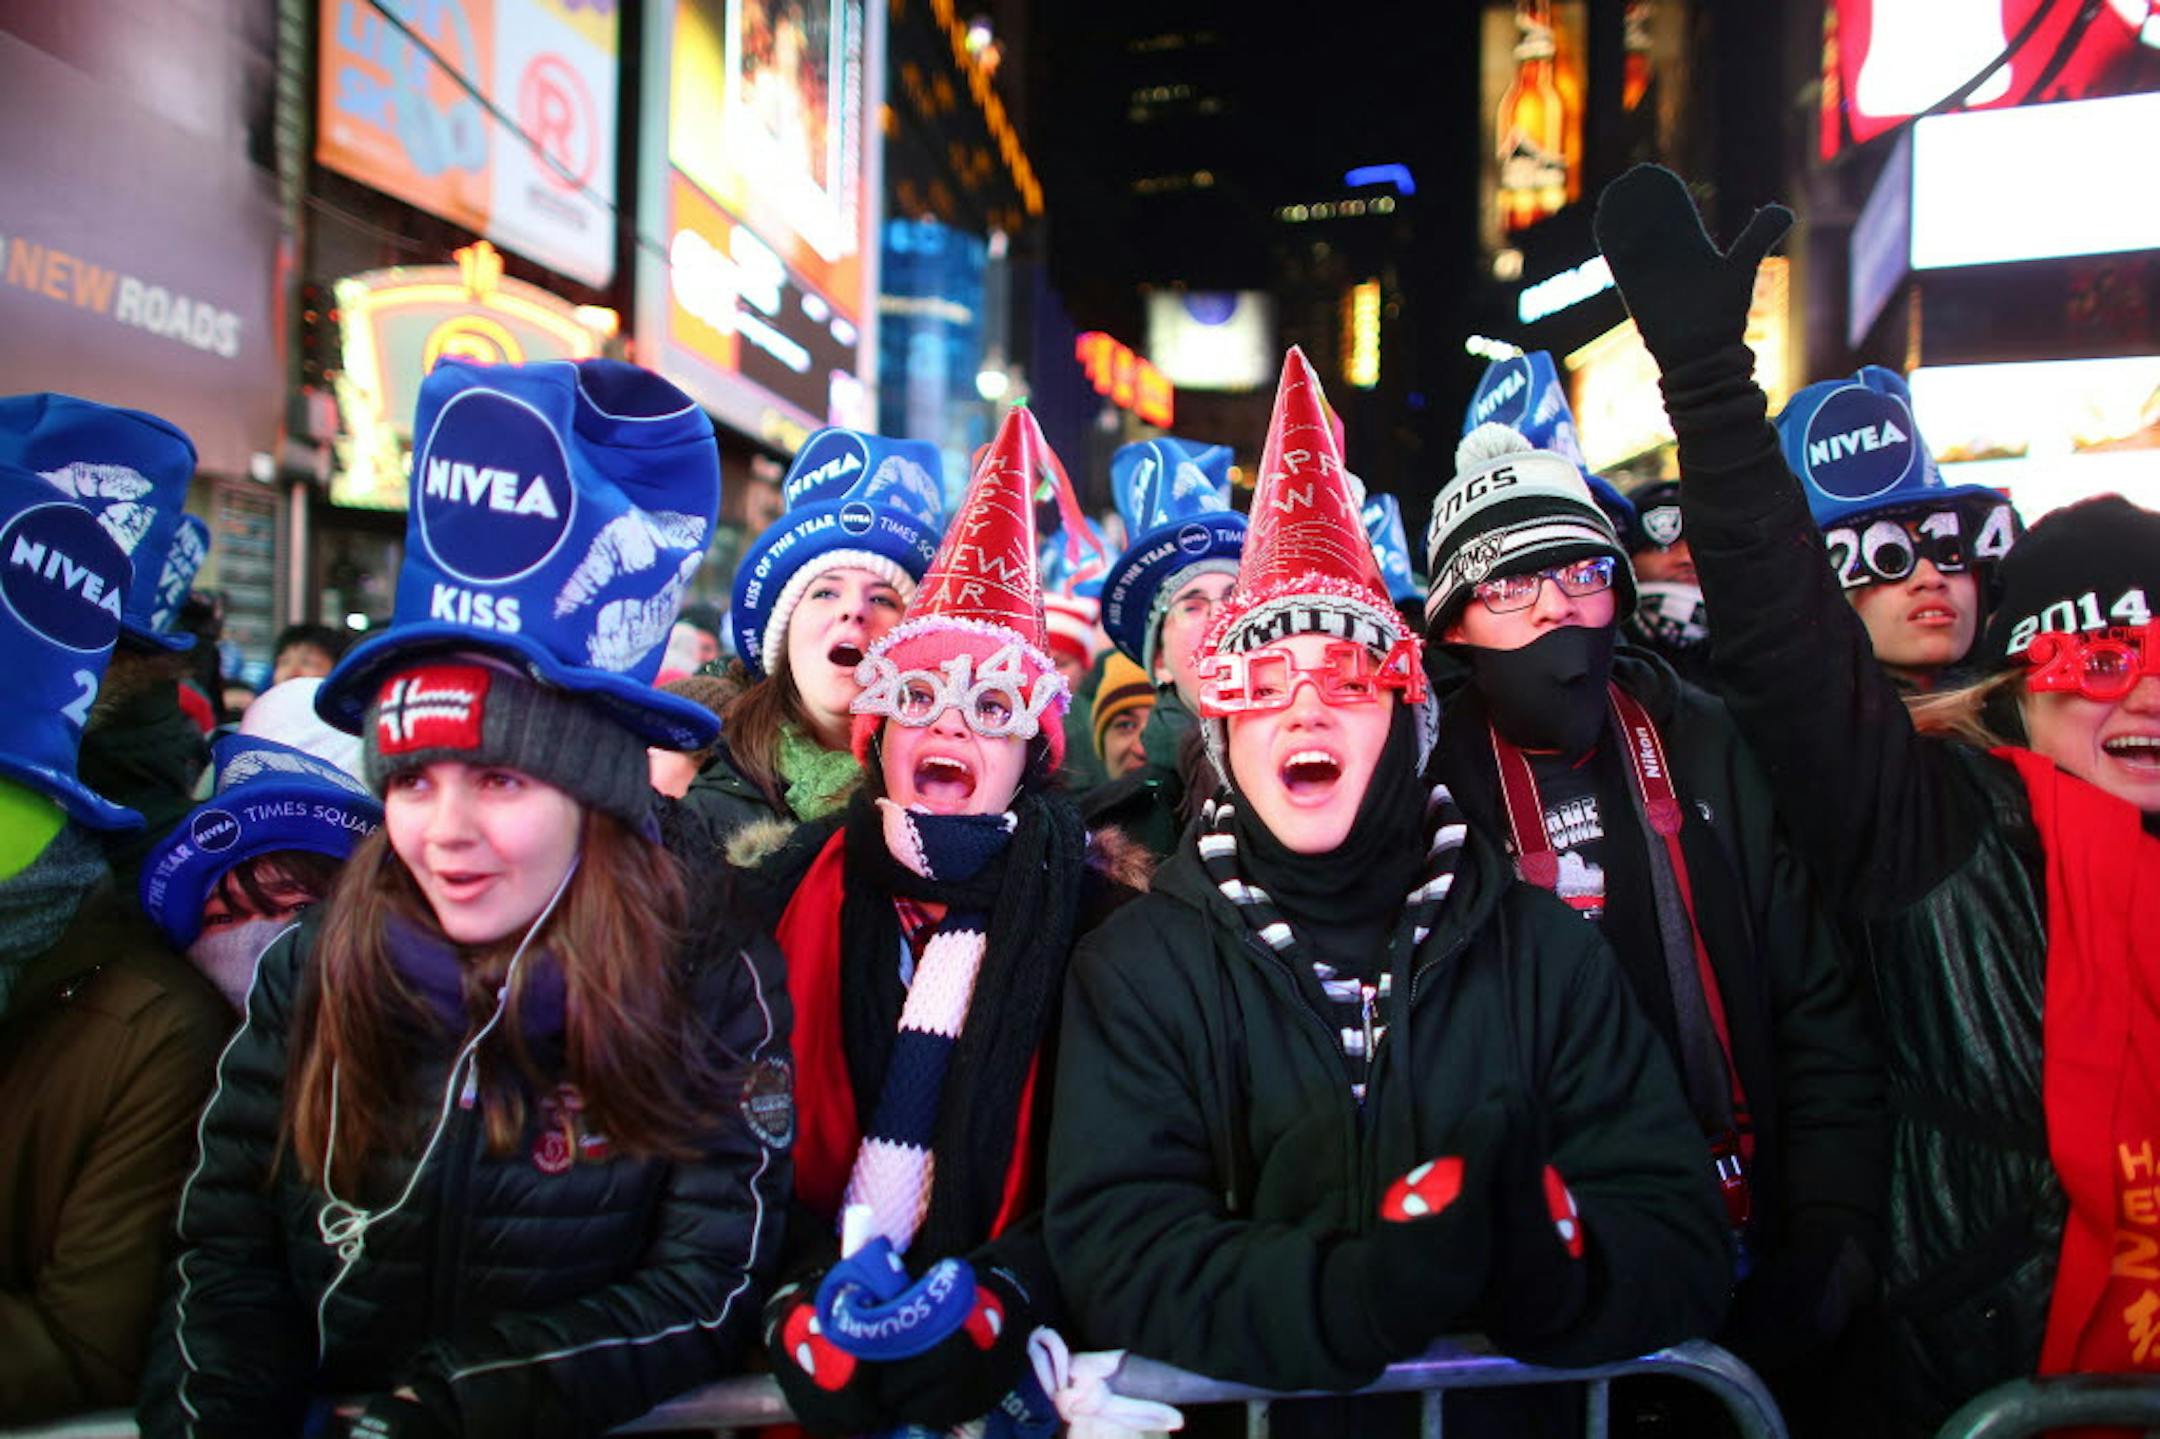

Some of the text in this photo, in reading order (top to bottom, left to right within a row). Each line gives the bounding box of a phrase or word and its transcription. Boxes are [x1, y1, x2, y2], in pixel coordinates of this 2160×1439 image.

[8, 237, 118, 313] NEW
[117, 278, 241, 357] ROADS
[1809, 420, 1907, 466] NIVEA
[427, 457, 558, 518] NIVEA
[787, 452, 863, 498] NIVEA
[11, 535, 122, 612] NIVEA
[744, 578, 763, 609] KISS
[754, 556, 773, 578] OF
[769, 532, 797, 559] THE
[795, 514, 836, 538] YEAR
[880, 516, 919, 544] TIMES
[1139, 542, 1177, 567] YEAR
[1826, 505, 2015, 590] 2014
[431, 584, 521, 633] KISS
[1112, 584, 1127, 602] OF
[1119, 565, 1143, 592] THE
[2005, 589, 2152, 656] 2014
[1199, 639, 1428, 719] 2014
[1635, 726, 1661, 778] Nikon
[150, 874, 167, 907] THE
[163, 844, 194, 880] YEAR
[195, 820, 235, 844] NIVEA
[244, 801, 307, 823] TIMES
